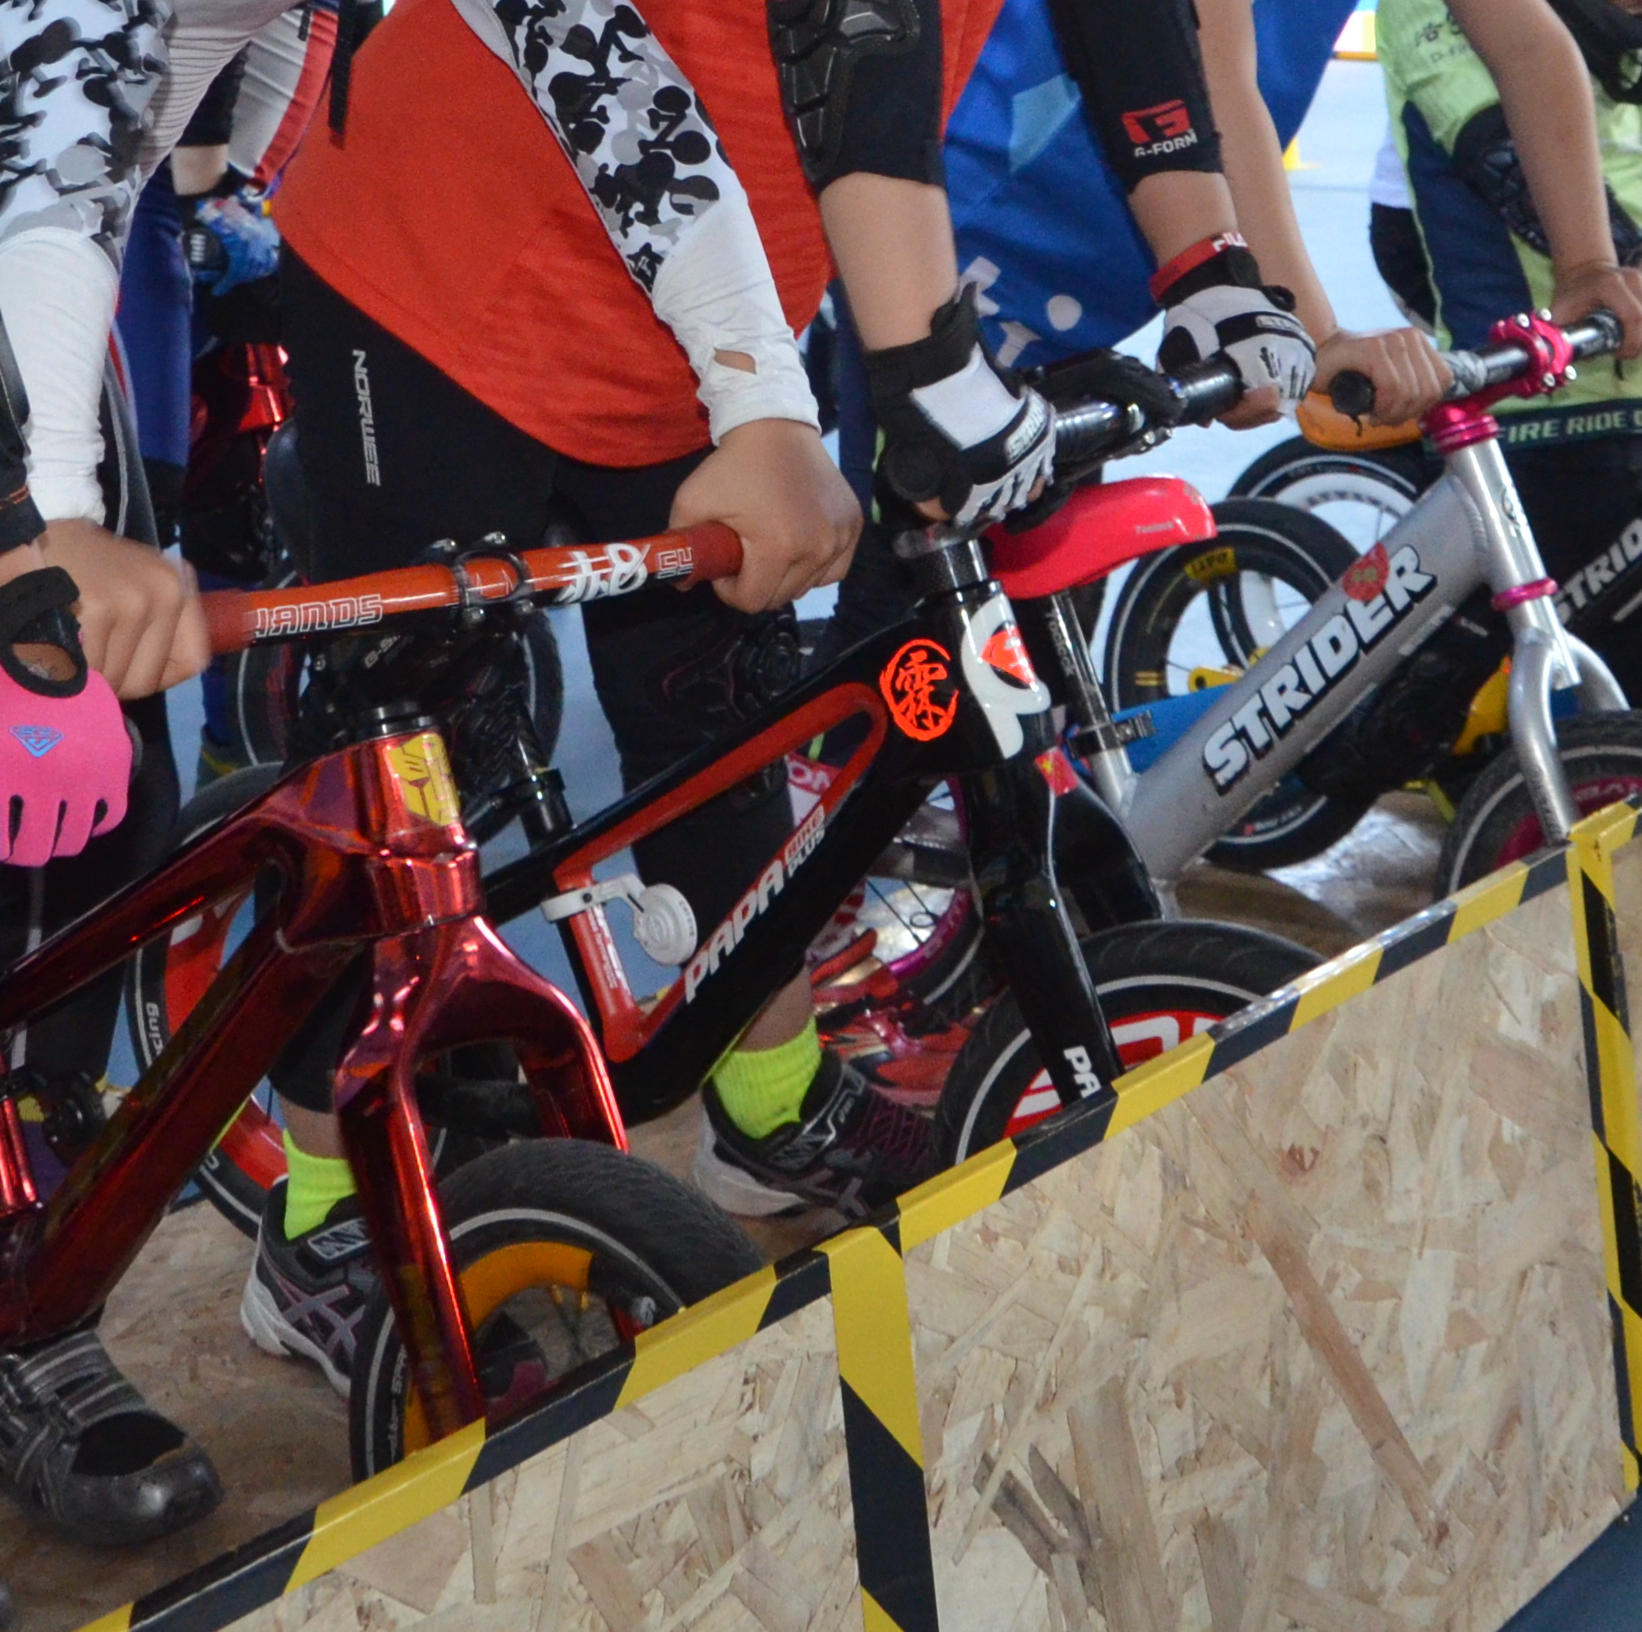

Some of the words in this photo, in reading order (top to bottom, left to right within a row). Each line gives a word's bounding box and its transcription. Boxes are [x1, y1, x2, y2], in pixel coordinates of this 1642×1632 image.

[1203, 541, 1438, 790] STRIDER
[684, 858, 785, 1005] PAPA
[1061, 1045, 1097, 1101] PA
